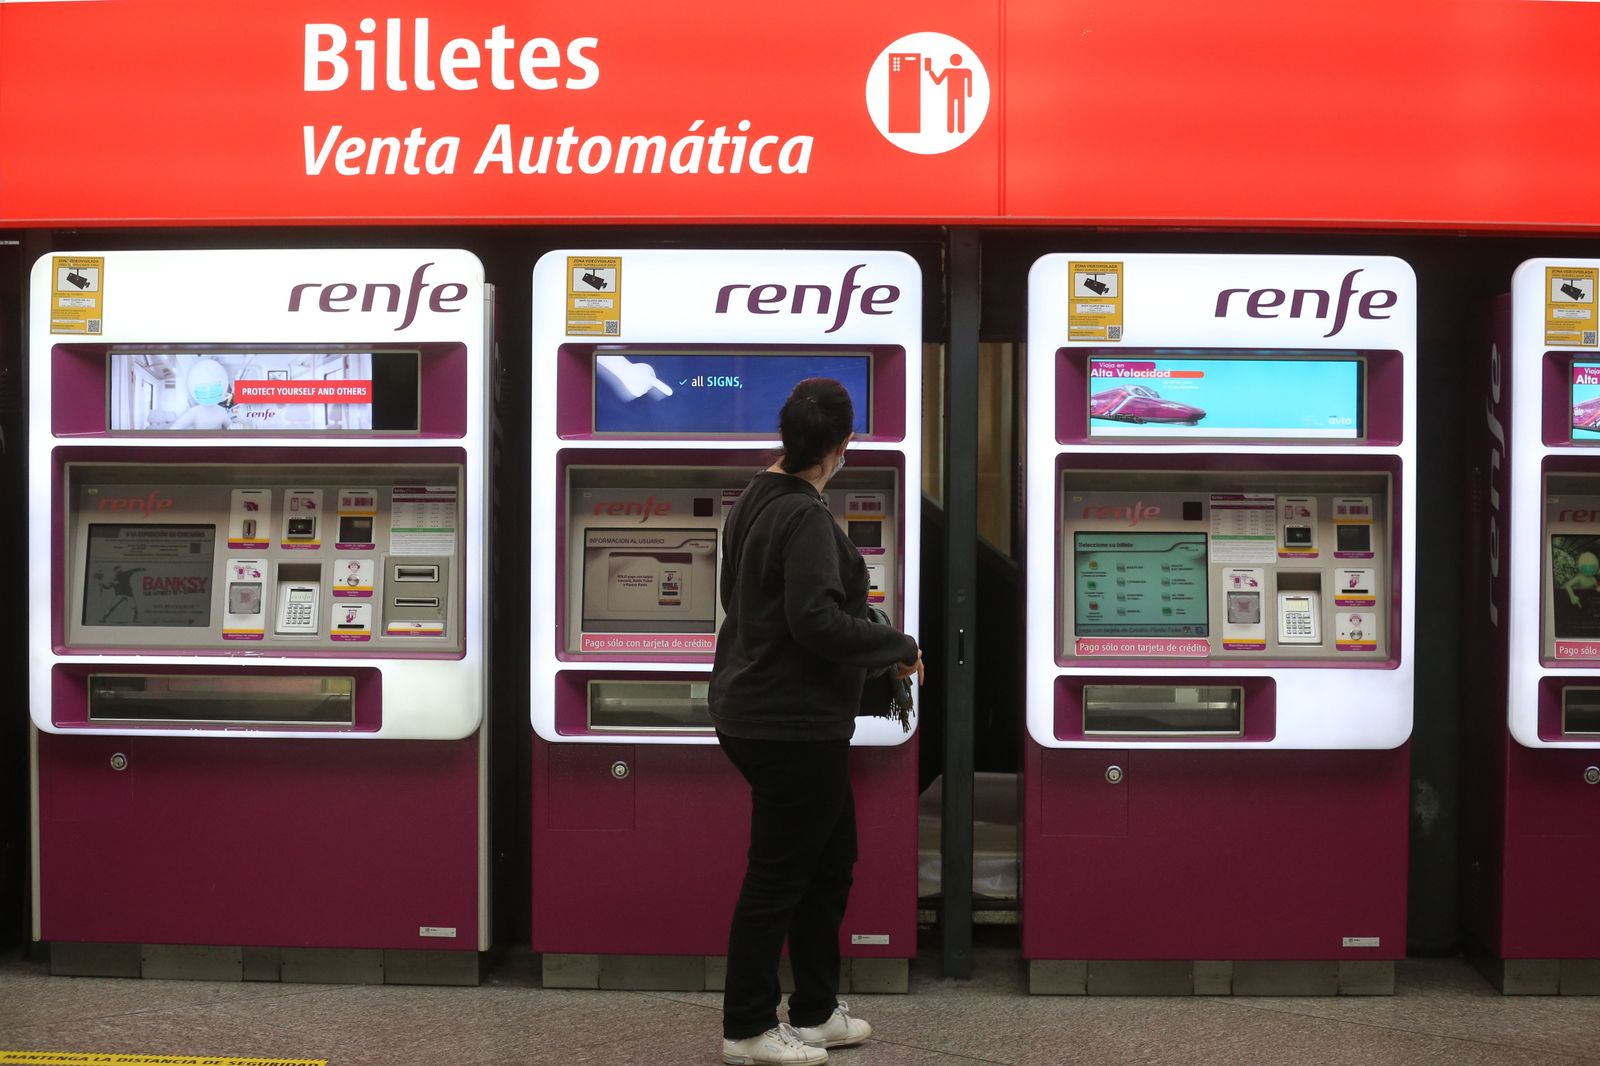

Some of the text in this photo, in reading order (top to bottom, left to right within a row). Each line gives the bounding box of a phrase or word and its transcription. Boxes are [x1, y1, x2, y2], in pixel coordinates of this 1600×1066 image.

[303, 17, 600, 93] Billetes
[302, 120, 814, 177] Venta Automática
[288, 262, 468, 331] renfe
[715, 263, 900, 334] renfe
[1214, 268, 1398, 338] renfe
[691, 376, 742, 389] all SIGNS,
[1091, 369, 1171, 377] Alta Velocidad
[1576, 374, 1598, 384] Alta
[242, 388, 367, 396] PROTECT YOURSELF AND OTHERS
[246, 409, 275, 420] renfe
[1486, 343, 1505, 628] renfe
[98, 490, 173, 518] renfe
[593, 496, 672, 523] renfe
[1083, 501, 1161, 527] renfe
[143, 576, 208, 590] BANKSY
[585, 639, 604, 648] Pago
[607, 639, 624, 647] sólo
[643, 640, 669, 648] tarjeta
[684, 639, 712, 648] crédito
[1080, 643, 1098, 653] Pago
[1102, 643, 1118, 651] sólo
[1137, 644, 1162, 652] tarjeta
[1165, 643, 1176, 651] de
[1179, 643, 1206, 652] crédito
[1559, 646, 1597, 656] Pago sólo
